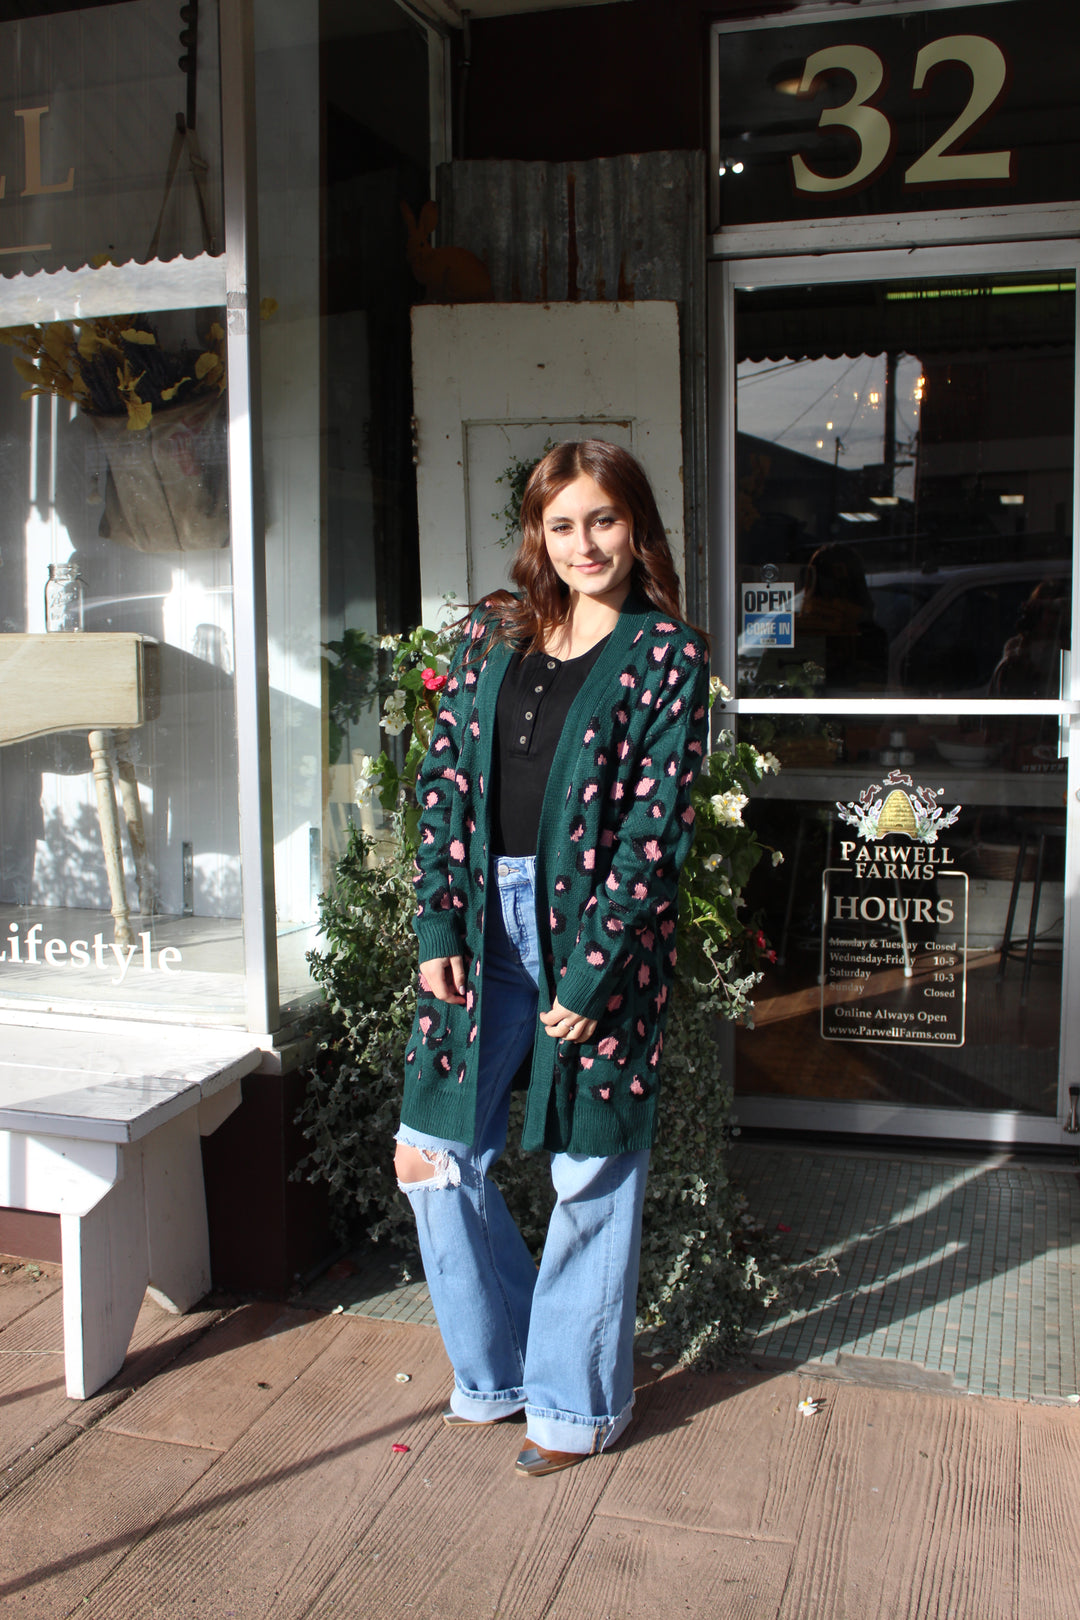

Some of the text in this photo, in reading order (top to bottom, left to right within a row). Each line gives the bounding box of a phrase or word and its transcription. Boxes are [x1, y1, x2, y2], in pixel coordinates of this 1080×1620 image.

[792, 35, 1011, 192] 32
[0, 105, 75, 199] L
[744, 590, 792, 612] OPEN
[746, 622, 790, 636] COME IN
[855, 862, 935, 880] FARMS
[833, 896, 954, 924] HOURS
[869, 939, 879, 948] &
[925, 941, 957, 951] Closed
[830, 952, 955, 967] Wednesday-Fridy 10-5
[829, 967, 955, 982] Saturday 10-3
[829, 981, 956, 998] Sunday Closed
[835, 1007, 948, 1024] Online Always Open
[828, 1025, 957, 1041] www.ParwellFarms.com
